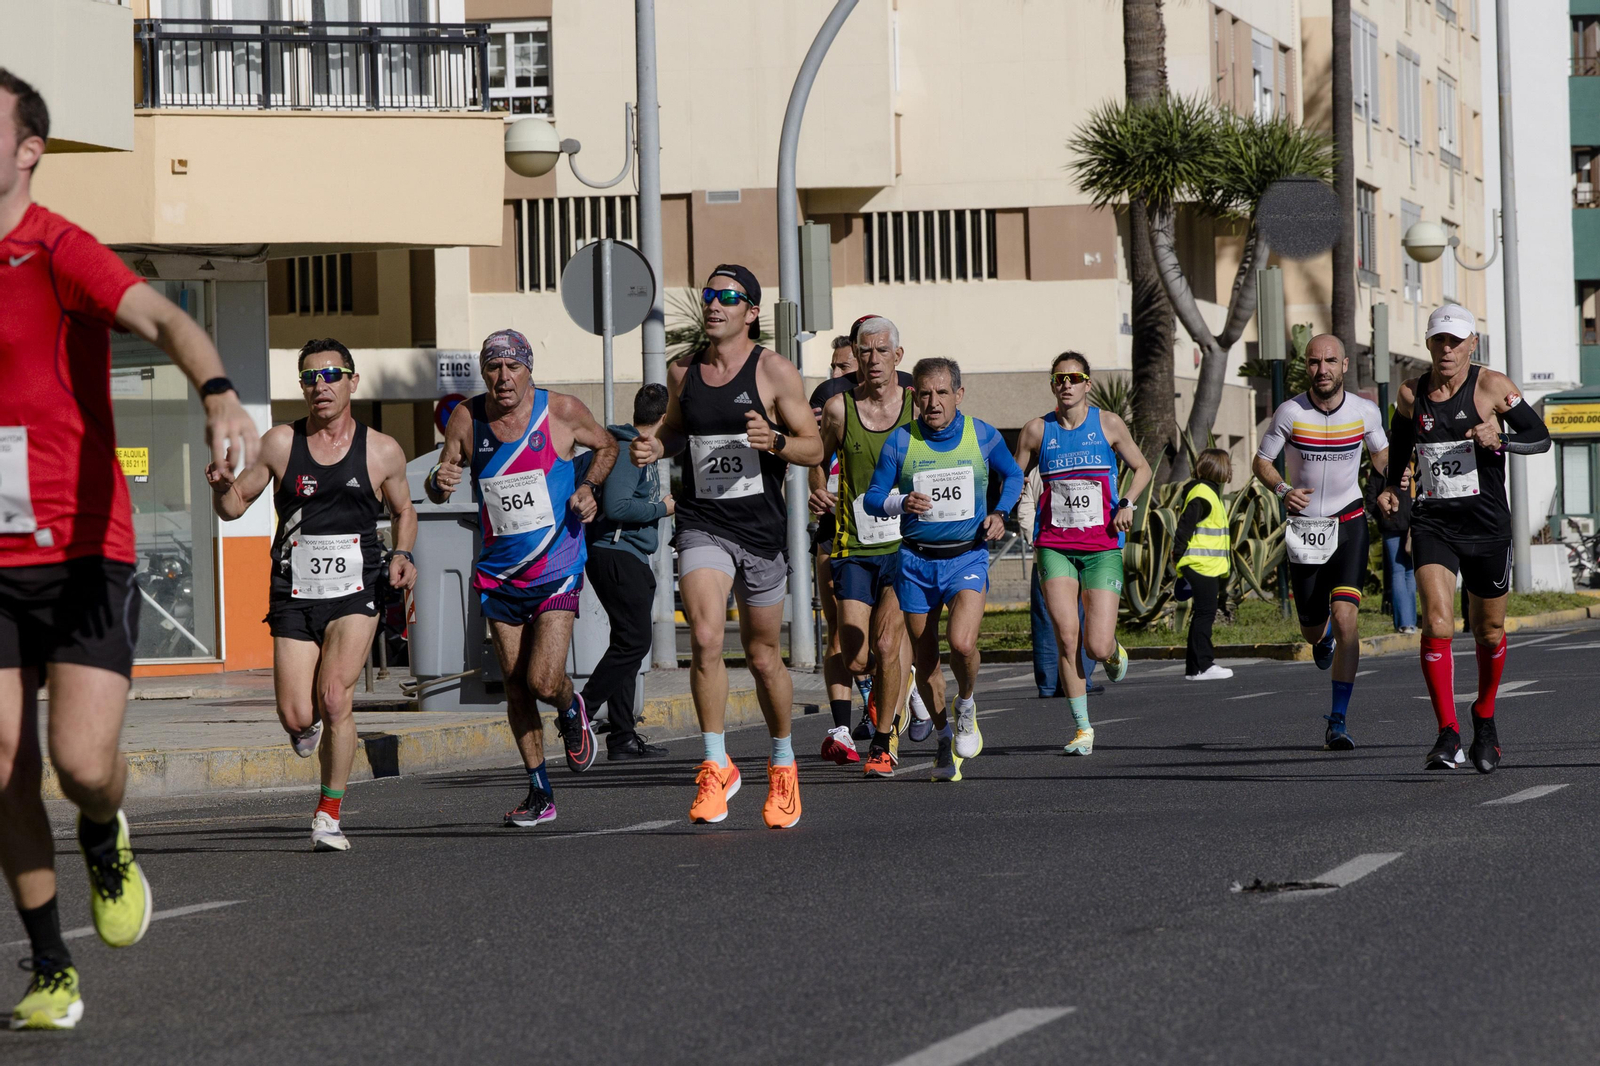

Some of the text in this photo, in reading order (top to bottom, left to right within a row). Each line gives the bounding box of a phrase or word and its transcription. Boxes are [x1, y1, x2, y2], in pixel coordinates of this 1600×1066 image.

[439, 362, 471, 378] ELIOS
[1048, 454, 1102, 470] CREDUS
[1301, 452, 1354, 461] ULTRASERIES
[708, 456, 743, 474] 263
[1431, 460, 1462, 476] 652
[501, 492, 535, 512] 564
[932, 486, 962, 502] 546
[1064, 495, 1090, 508] 449
[1300, 532, 1326, 546] 190
[310, 557, 346, 574] 378
